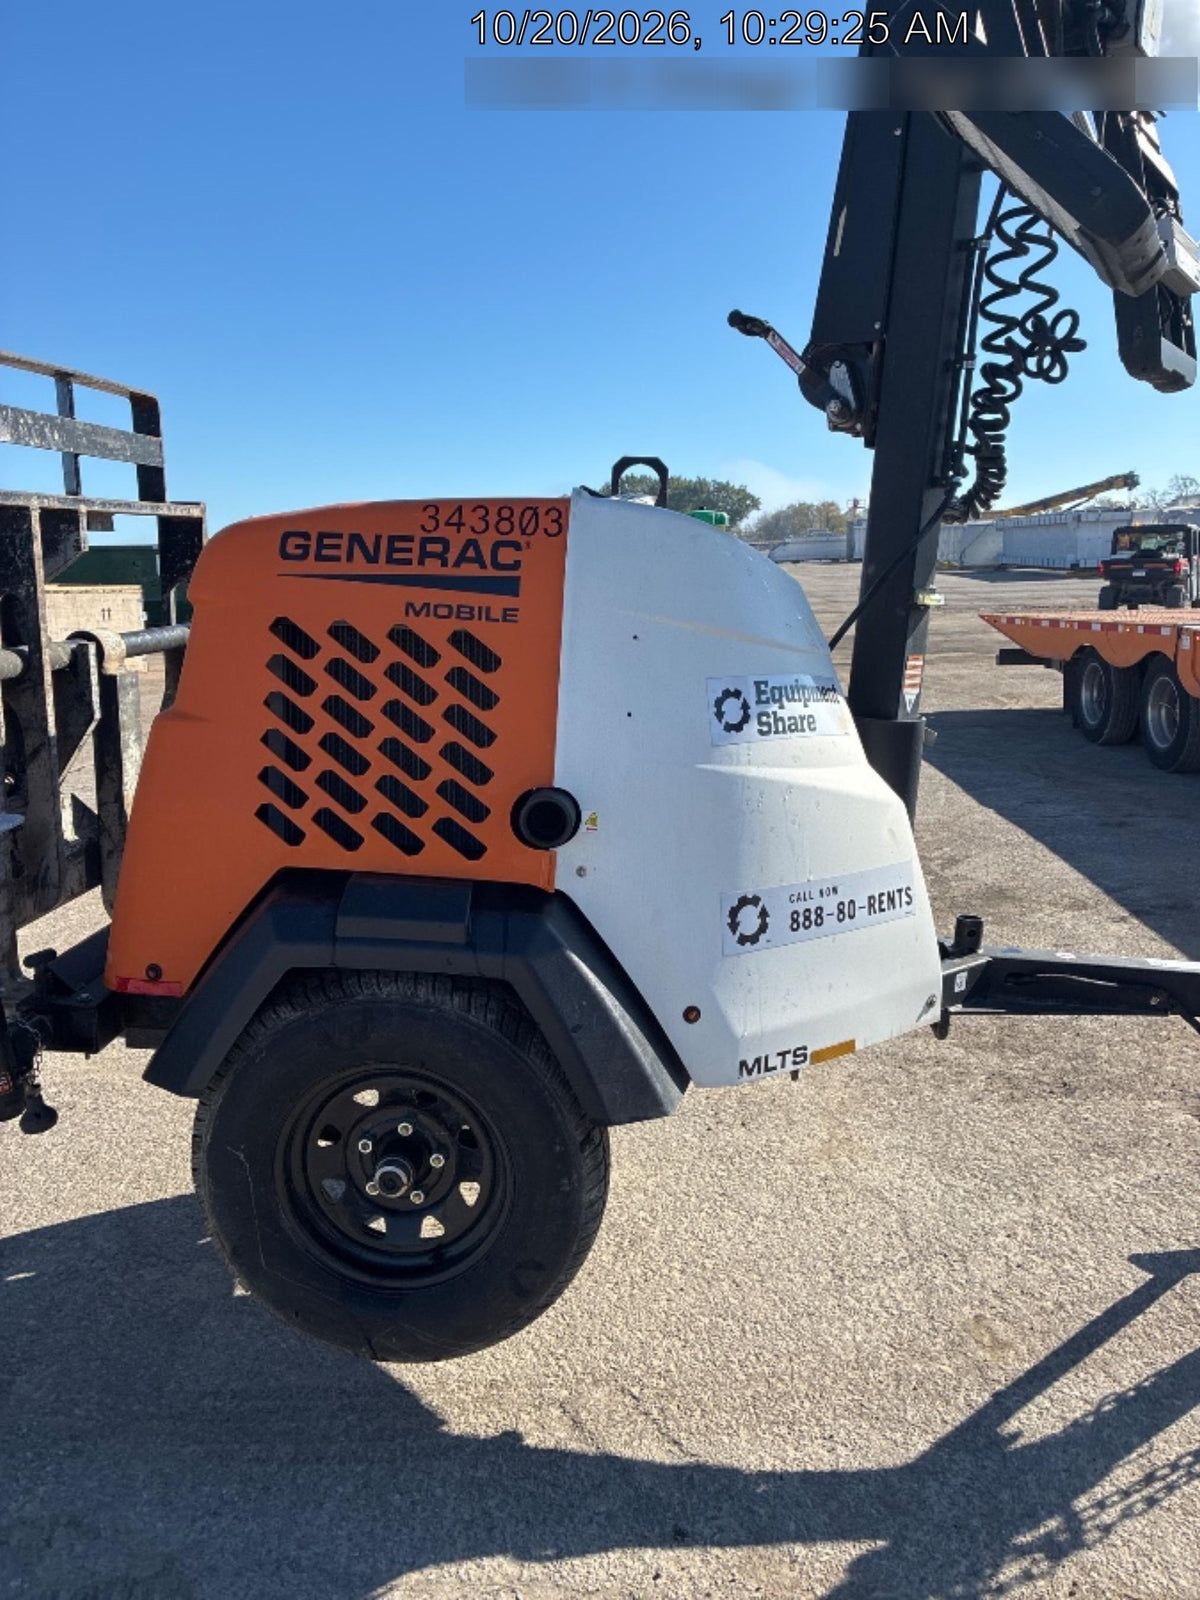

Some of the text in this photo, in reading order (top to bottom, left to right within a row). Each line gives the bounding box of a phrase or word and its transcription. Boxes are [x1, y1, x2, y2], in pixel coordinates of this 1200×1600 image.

[420, 503, 564, 537] 343803
[279, 531, 522, 571] GENERAC
[404, 602, 520, 623] MOBILE
[757, 710, 817, 736] Share
[788, 886, 839, 903] CALL NOW
[789, 887, 913, 932] 888-80-RENTS
[739, 1045, 808, 1077] MLTS
